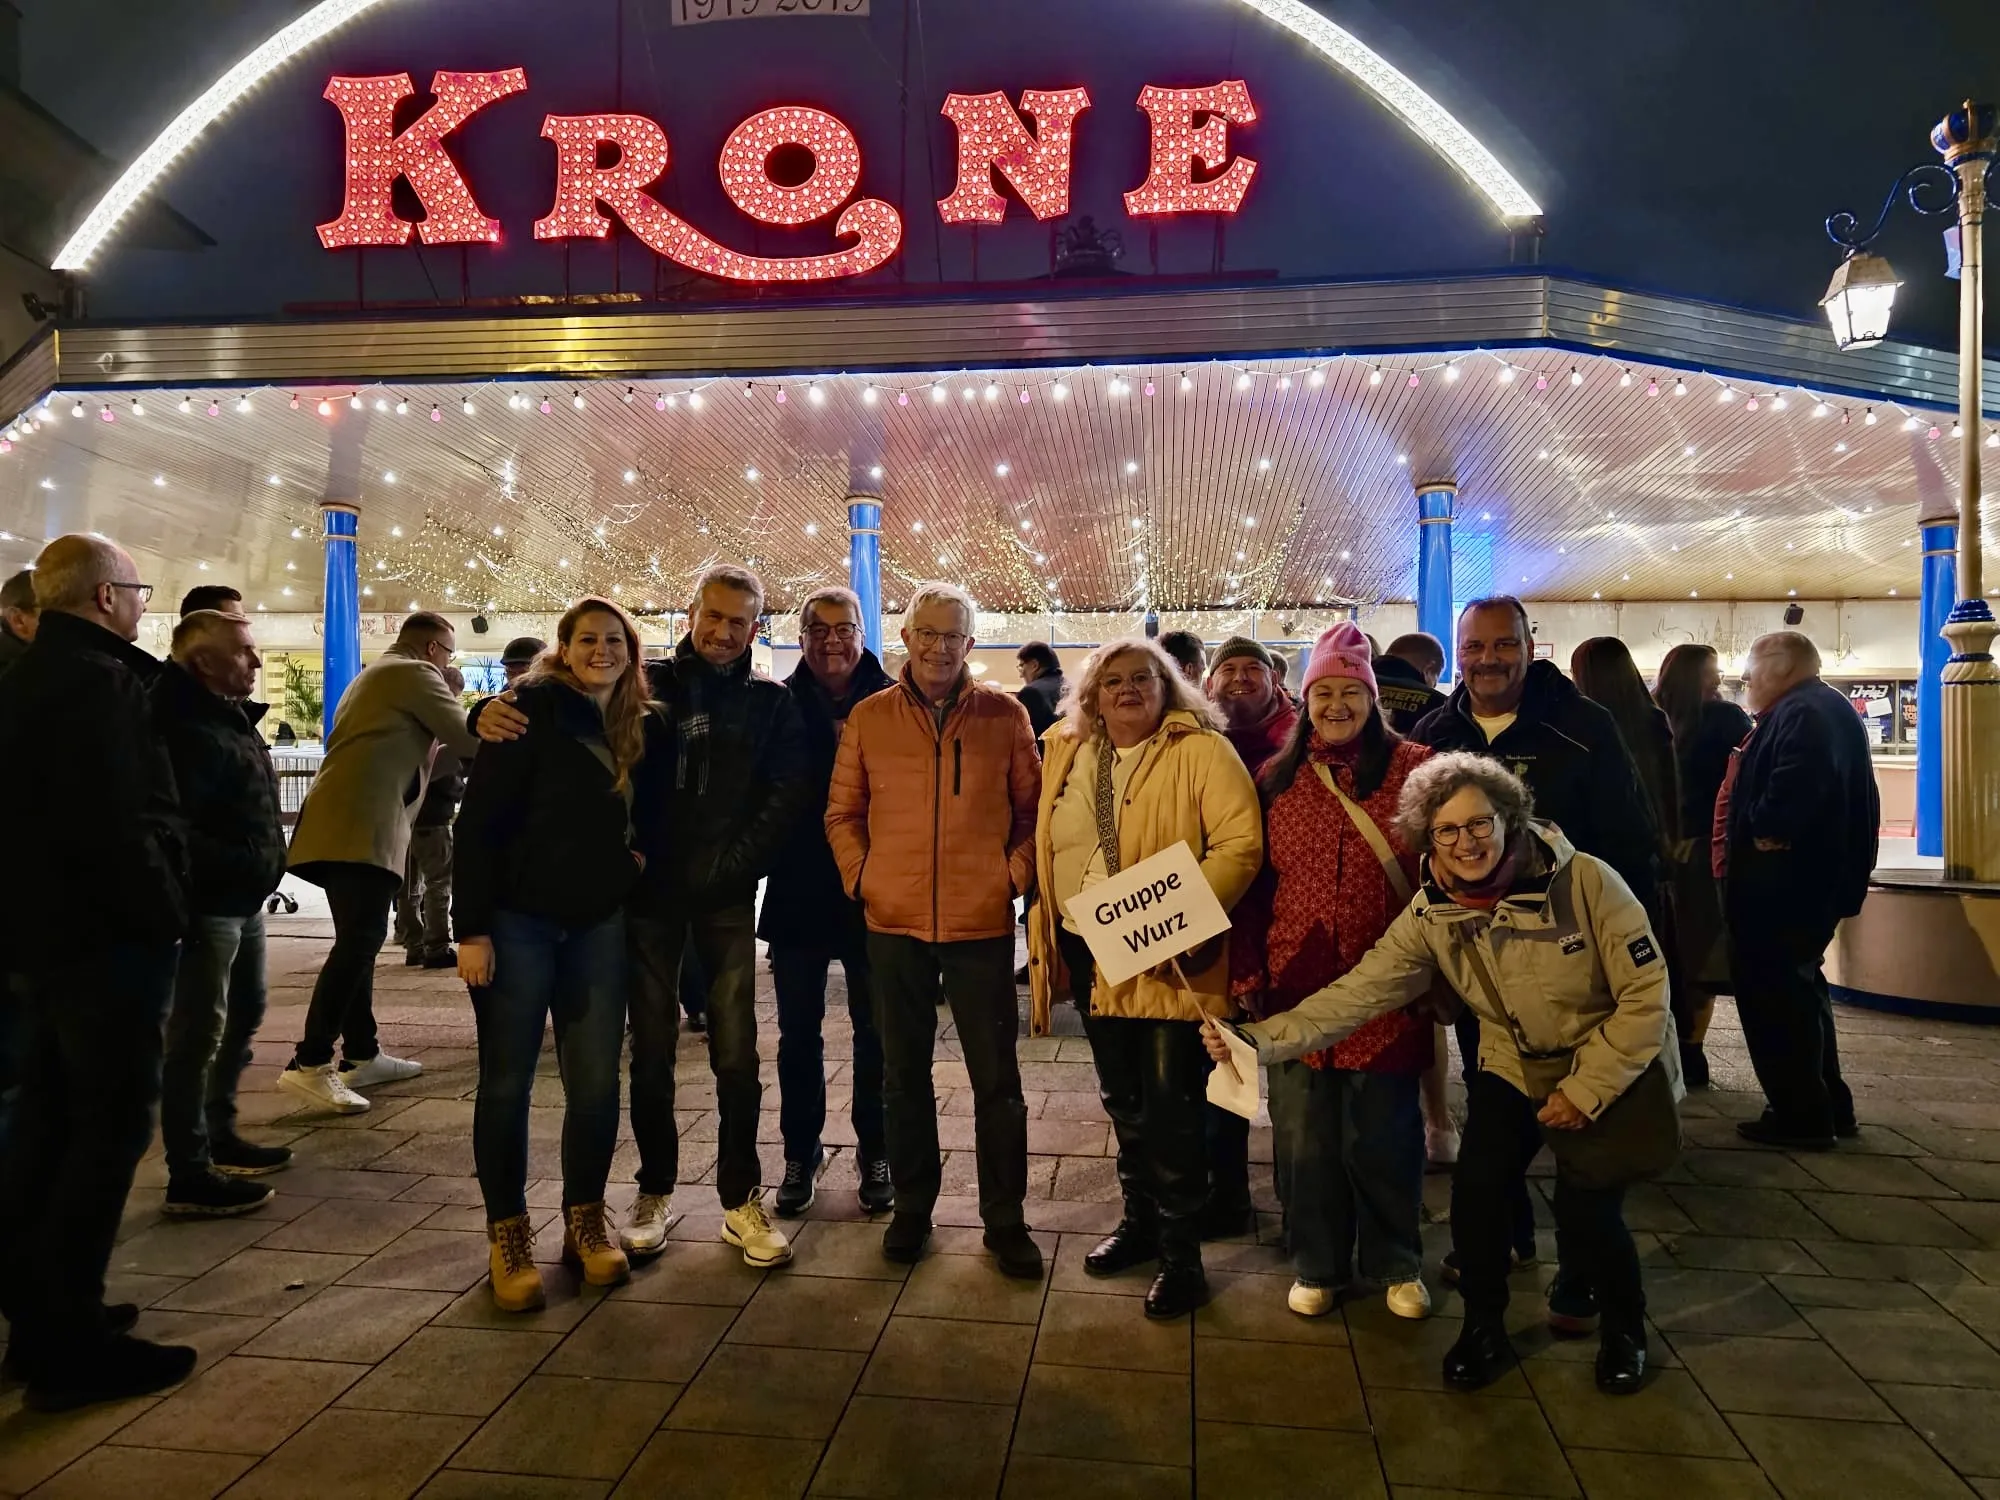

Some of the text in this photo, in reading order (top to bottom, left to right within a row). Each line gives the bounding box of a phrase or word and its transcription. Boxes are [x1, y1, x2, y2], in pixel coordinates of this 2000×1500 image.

[316, 66, 1259, 281] KRONE
[1095, 872, 1182, 925] Gruppe
[1123, 911, 1188, 954] Wurz
